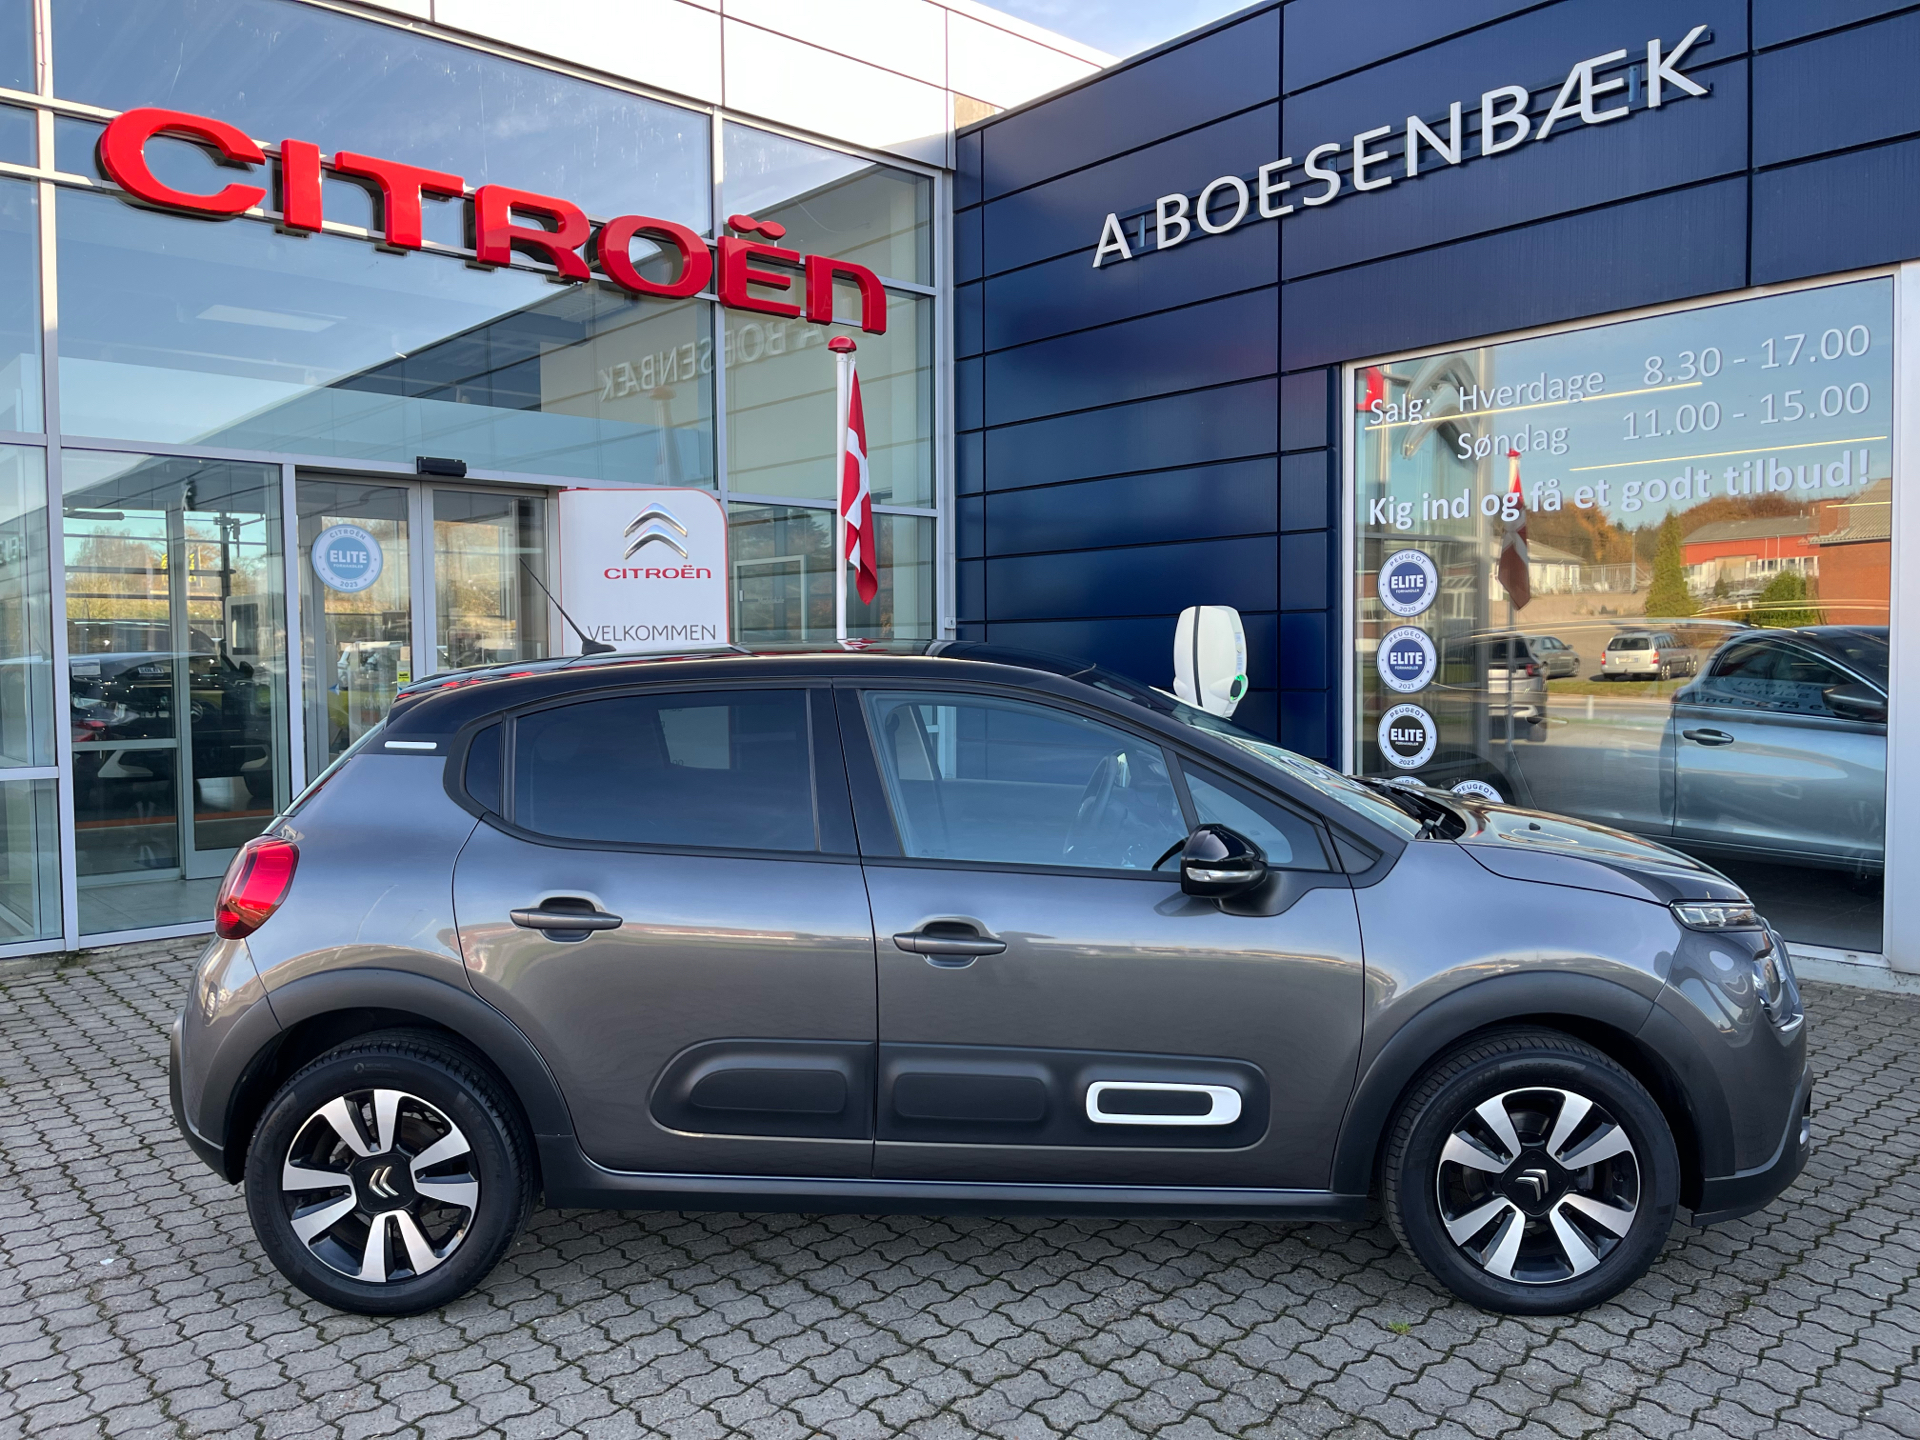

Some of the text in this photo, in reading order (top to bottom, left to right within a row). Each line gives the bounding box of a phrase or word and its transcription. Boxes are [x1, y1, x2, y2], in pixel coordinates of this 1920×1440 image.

[1092, 24, 1709, 268] A BOESENBÆK
[1369, 393, 1431, 426] Salg:
[1458, 371, 1605, 403] Hverdage
[1643, 347, 1722, 386] 8.30
[1761, 324, 1870, 369] 17.00
[1457, 424, 1570, 460] Søndag
[1622, 401, 1721, 440] 11.00
[1760, 382, 1870, 425] 15.00
[1369, 449, 1870, 530] Kig ind og få et godt tilbud!
[330, 550, 367, 563] ELITE
[1390, 553, 1427, 567] PEUGEOT
[340, 580, 359, 588] 2023
[1391, 574, 1424, 589] ELITE
[587, 624, 717, 641] VELKOMMEN
[1389, 630, 1426, 643] PEUGEOT
[1390, 652, 1423, 665] ELITE
[1389, 706, 1426, 719] PEUGEOT
[1390, 728, 1424, 742] ELITE
[1456, 783, 1496, 797] PEUGEOT
